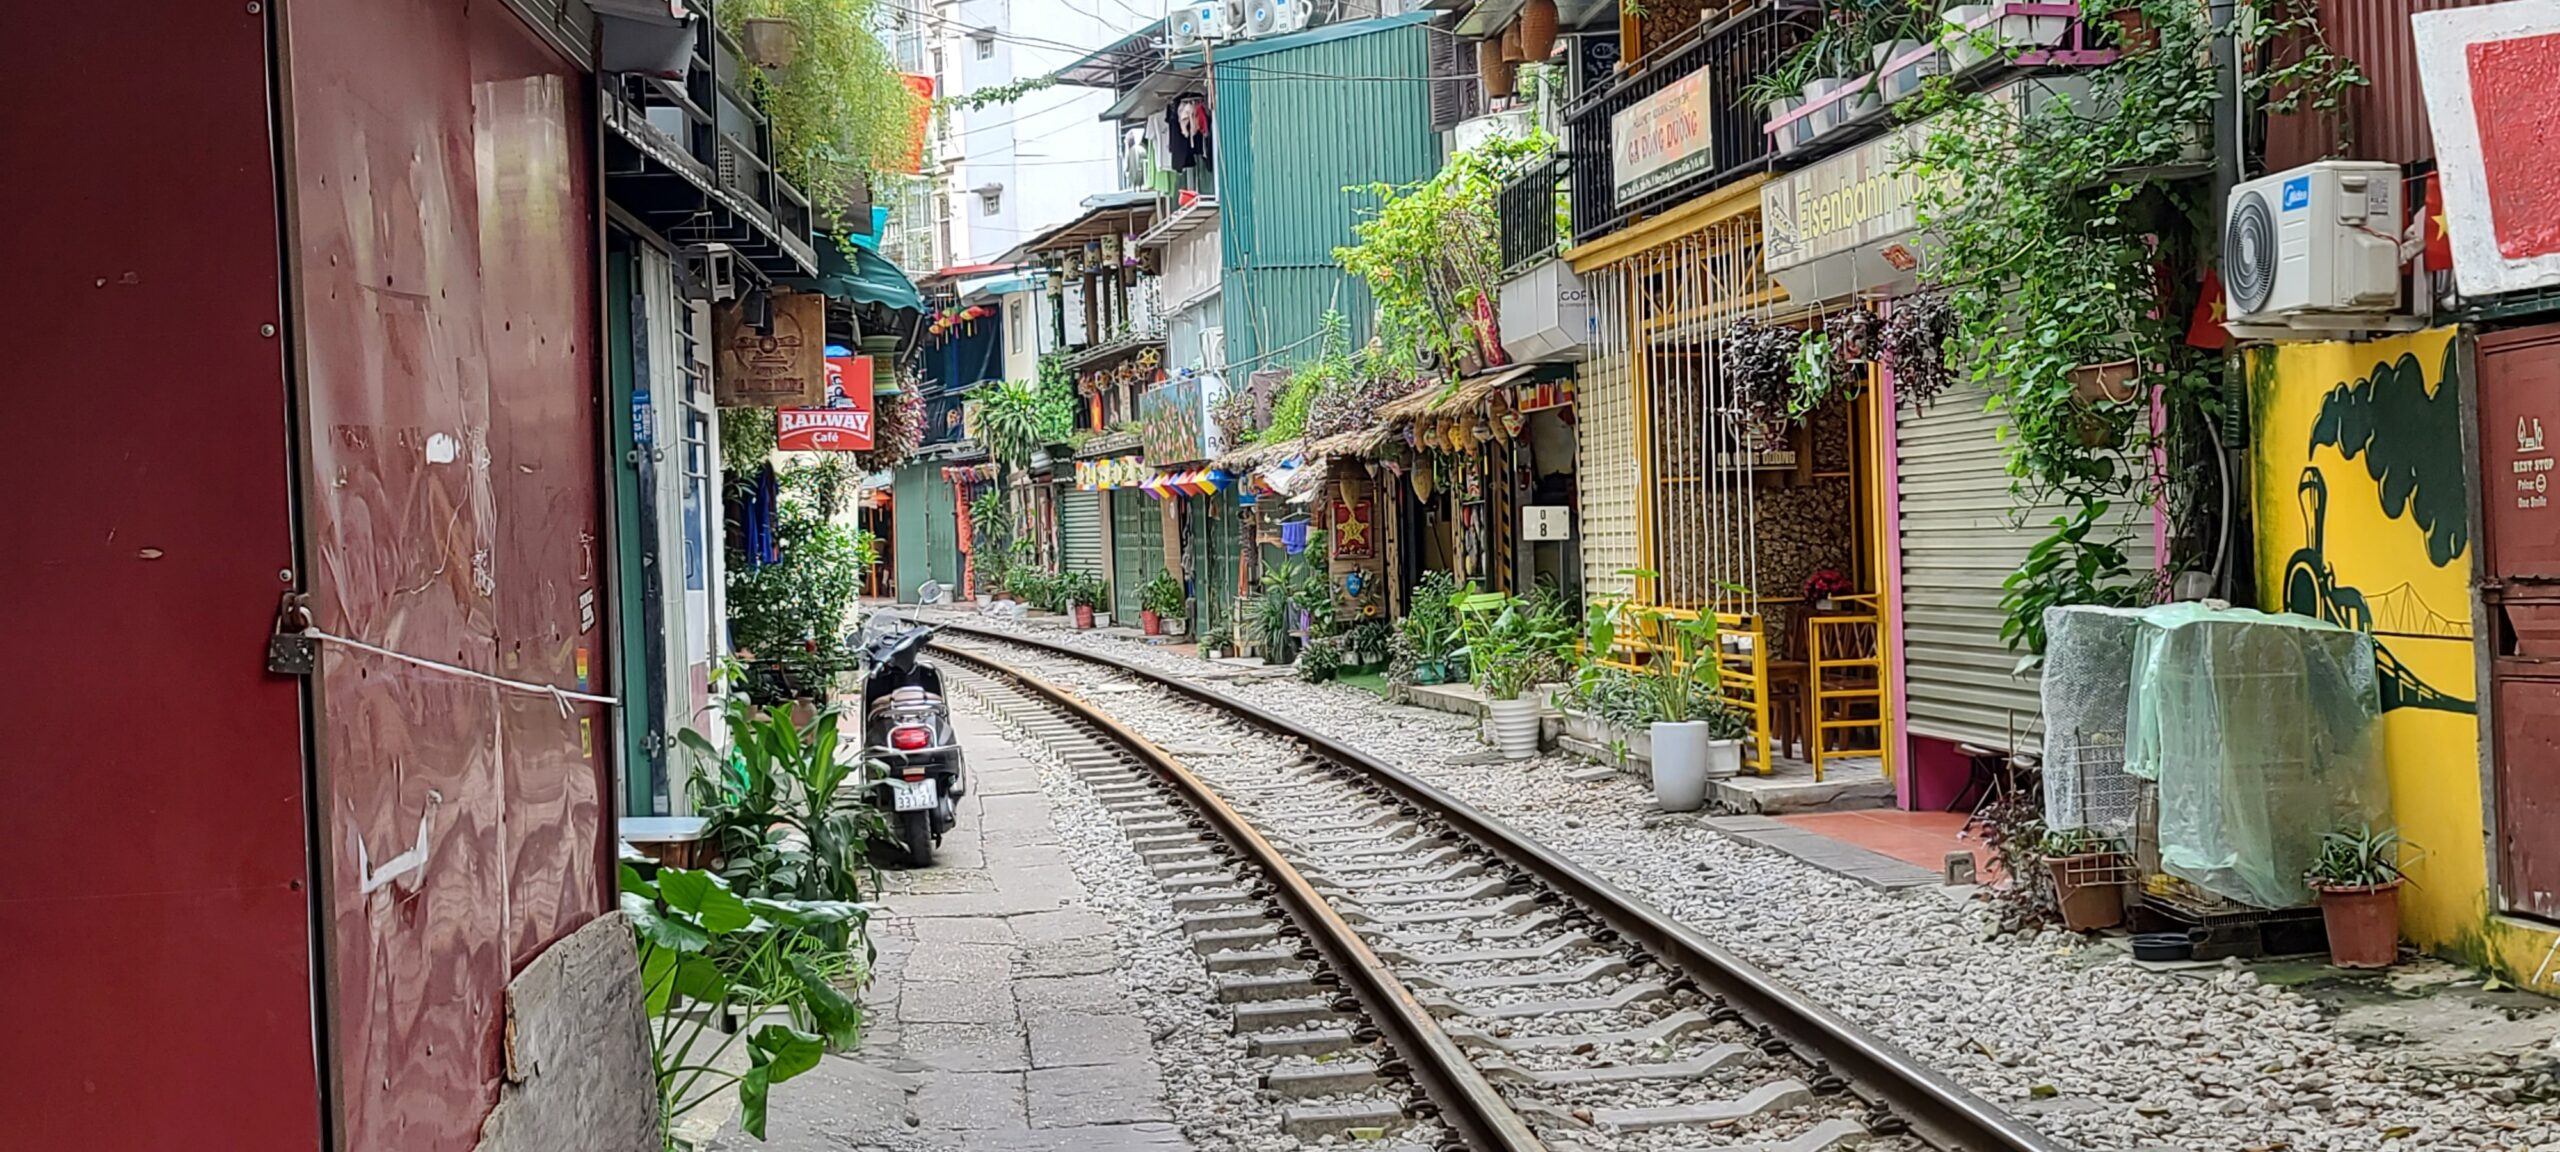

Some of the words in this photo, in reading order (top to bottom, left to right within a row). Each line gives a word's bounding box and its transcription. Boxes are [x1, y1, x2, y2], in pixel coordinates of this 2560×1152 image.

[1628, 140, 1639, 165] GA
[1797, 167, 1891, 241] Eisenbahn
[633, 404, 643, 442] PUSH
[781, 413, 869, 432] RAILWAY
[813, 432, 839, 442] Café
[2513, 461, 2533, 473] REST
[2534, 458, 2554, 471] STOP
[1540, 522, 1547, 537] 8
